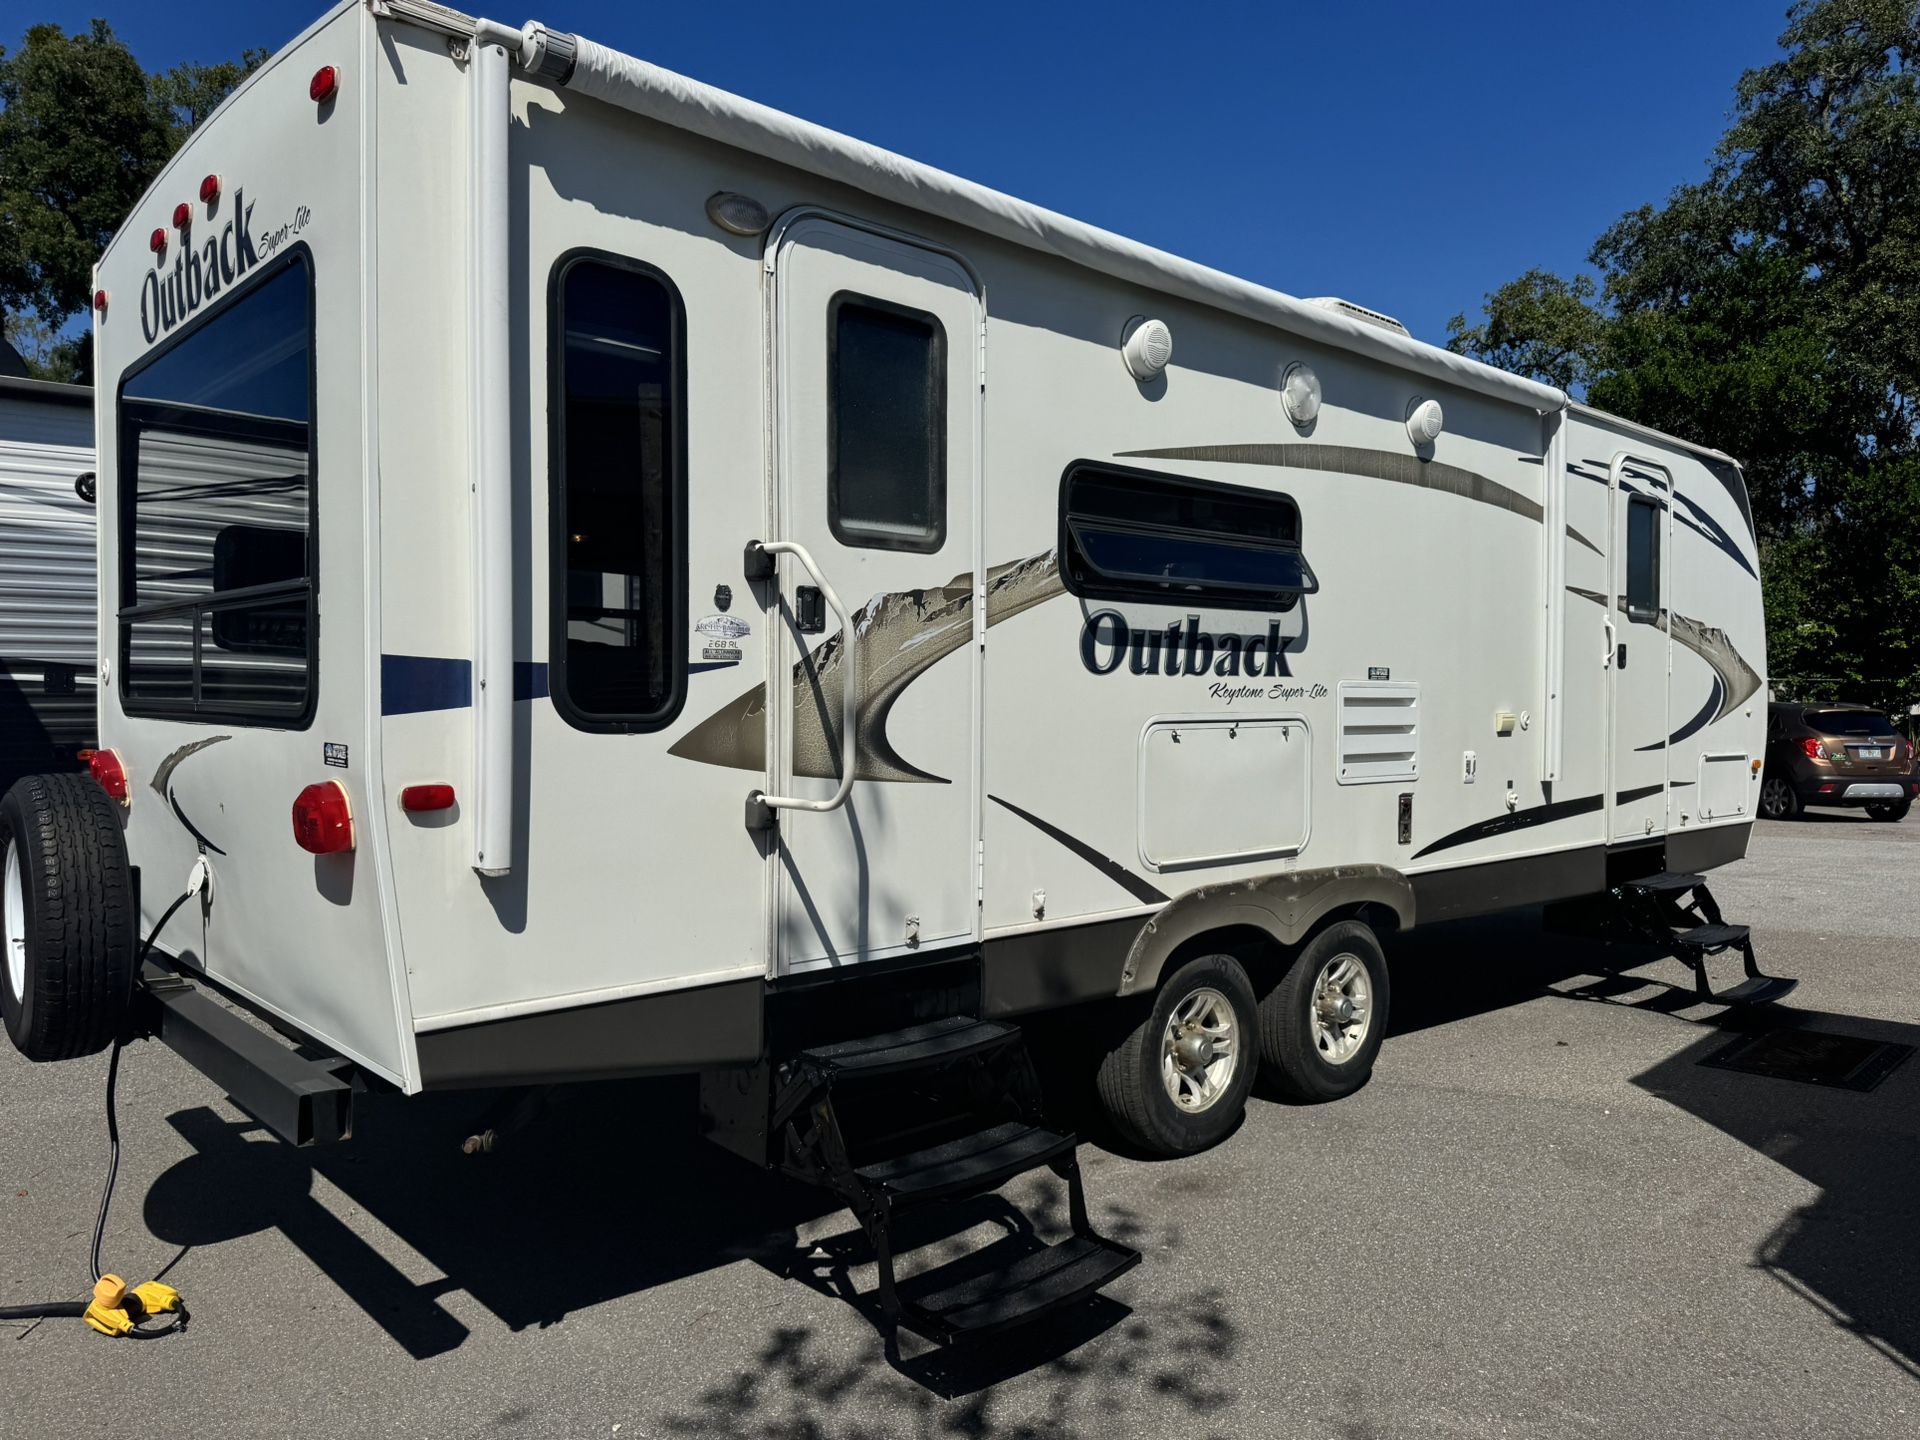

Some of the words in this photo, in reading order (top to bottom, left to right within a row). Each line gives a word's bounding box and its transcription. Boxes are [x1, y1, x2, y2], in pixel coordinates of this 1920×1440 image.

[141, 185, 259, 344] Outback
[257, 204, 311, 260] Super-Lite
[1079, 608, 1297, 678] Outback
[1208, 682, 1264, 705] Keystone
[1268, 684, 1328, 702] Super-Lite
